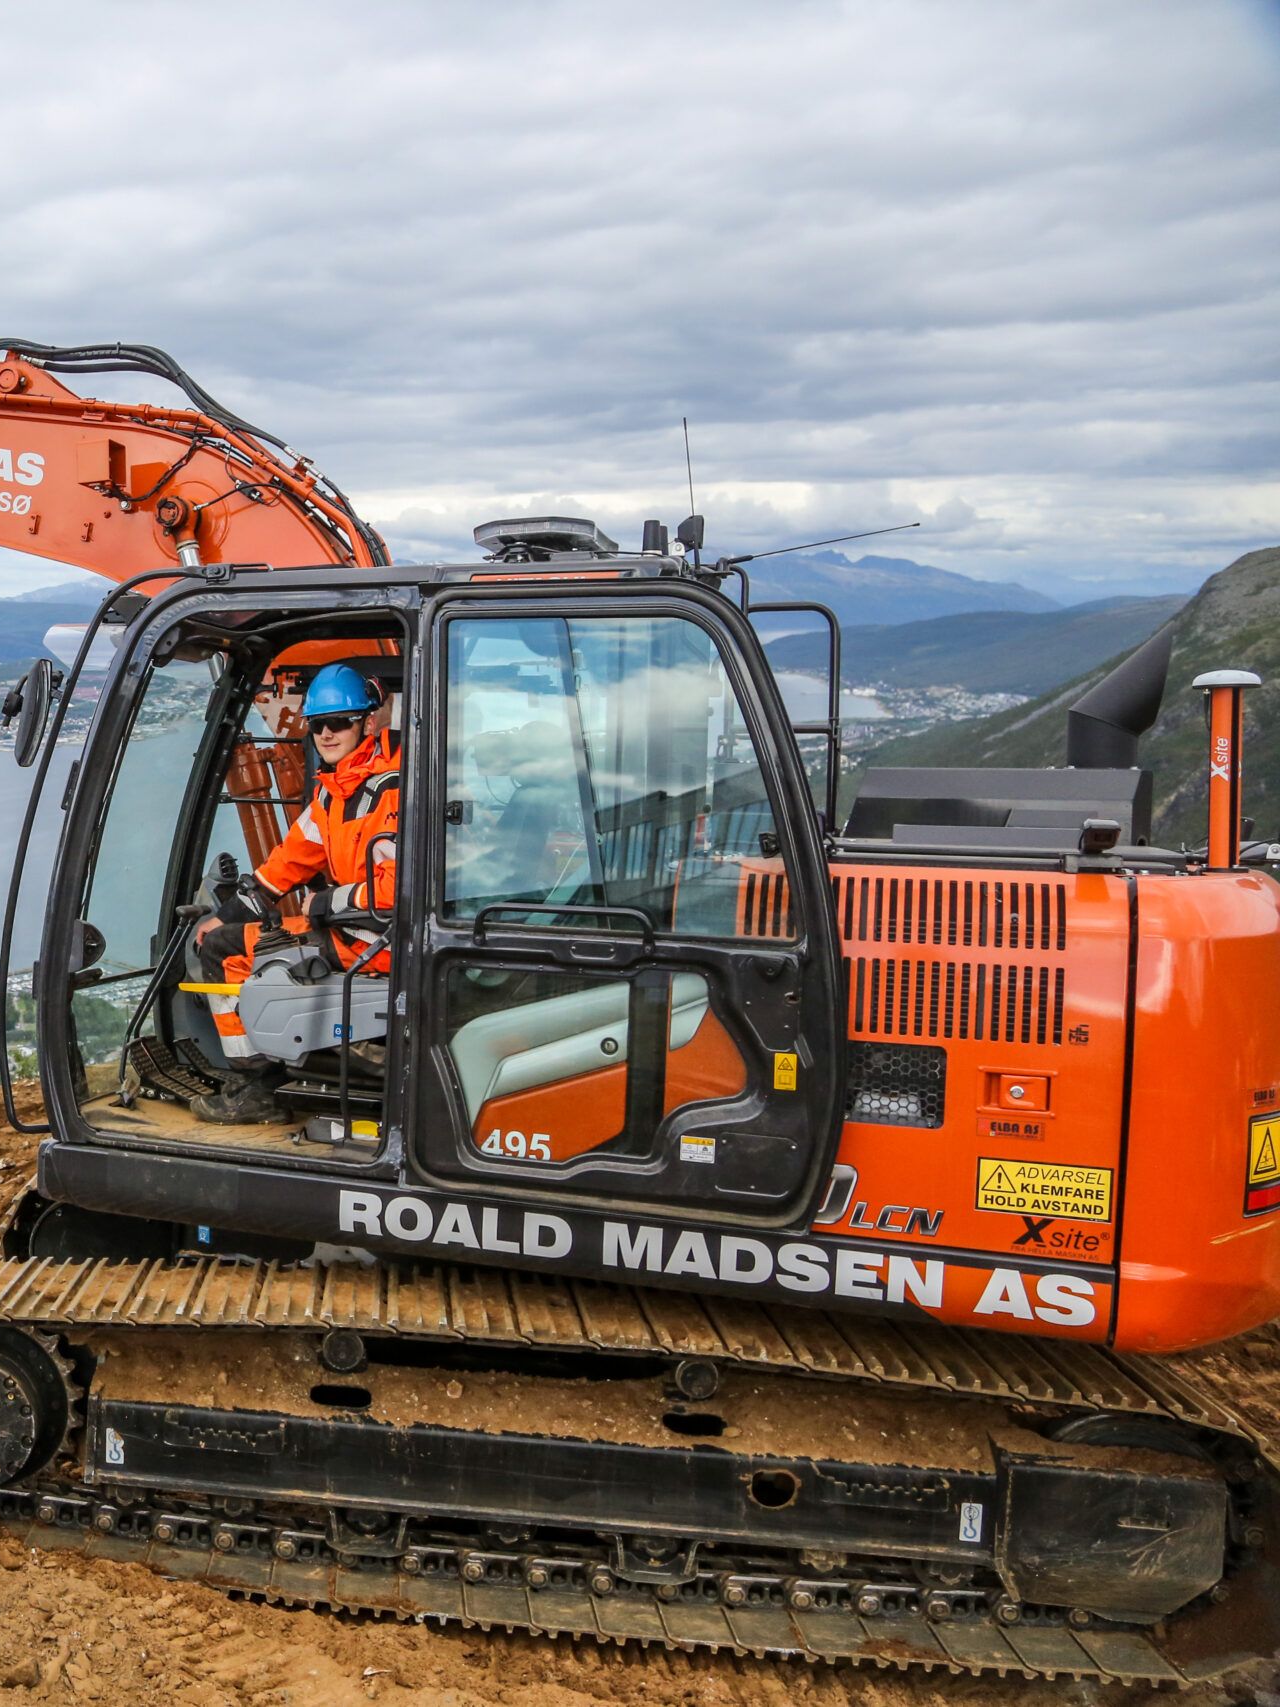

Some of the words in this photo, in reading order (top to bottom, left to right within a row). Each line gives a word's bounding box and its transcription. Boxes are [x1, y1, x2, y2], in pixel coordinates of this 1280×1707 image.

[480, 1129, 551, 1161] 495
[1016, 1166, 1106, 1186] ADVARSEL
[1021, 1183, 1105, 1201] KLEMFARE
[983, 1194, 1027, 1208] HOLD
[1031, 1199, 1104, 1216] AVSTAND
[339, 1189, 573, 1259] ROALD
[603, 1221, 945, 1309] MADSEN
[973, 1268, 1095, 1327] AS
